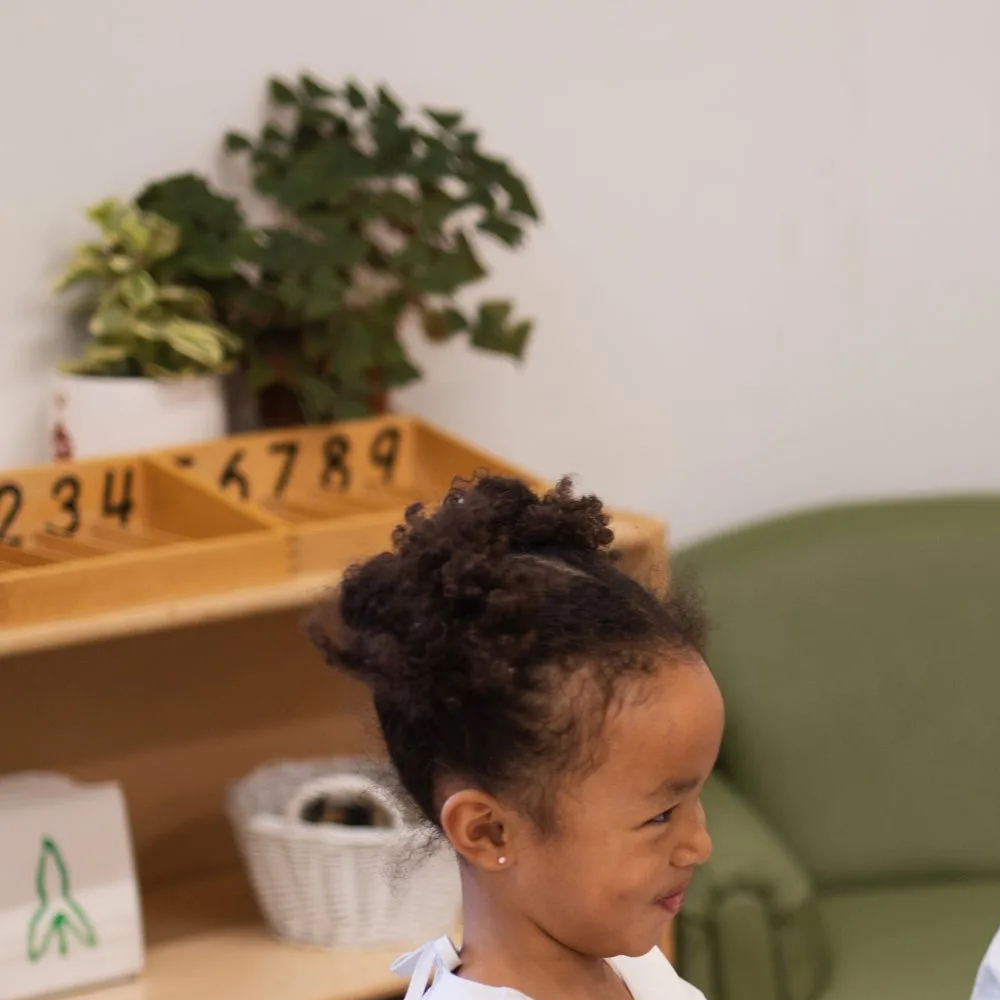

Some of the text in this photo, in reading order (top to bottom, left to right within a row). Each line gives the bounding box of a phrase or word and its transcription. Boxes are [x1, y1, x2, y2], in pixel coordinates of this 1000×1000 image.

[269, 440, 300, 498] 7
[321, 433, 352, 492] 8
[368, 426, 403, 485] 9
[46, 474, 82, 537] 3
[101, 467, 135, 526] 4
